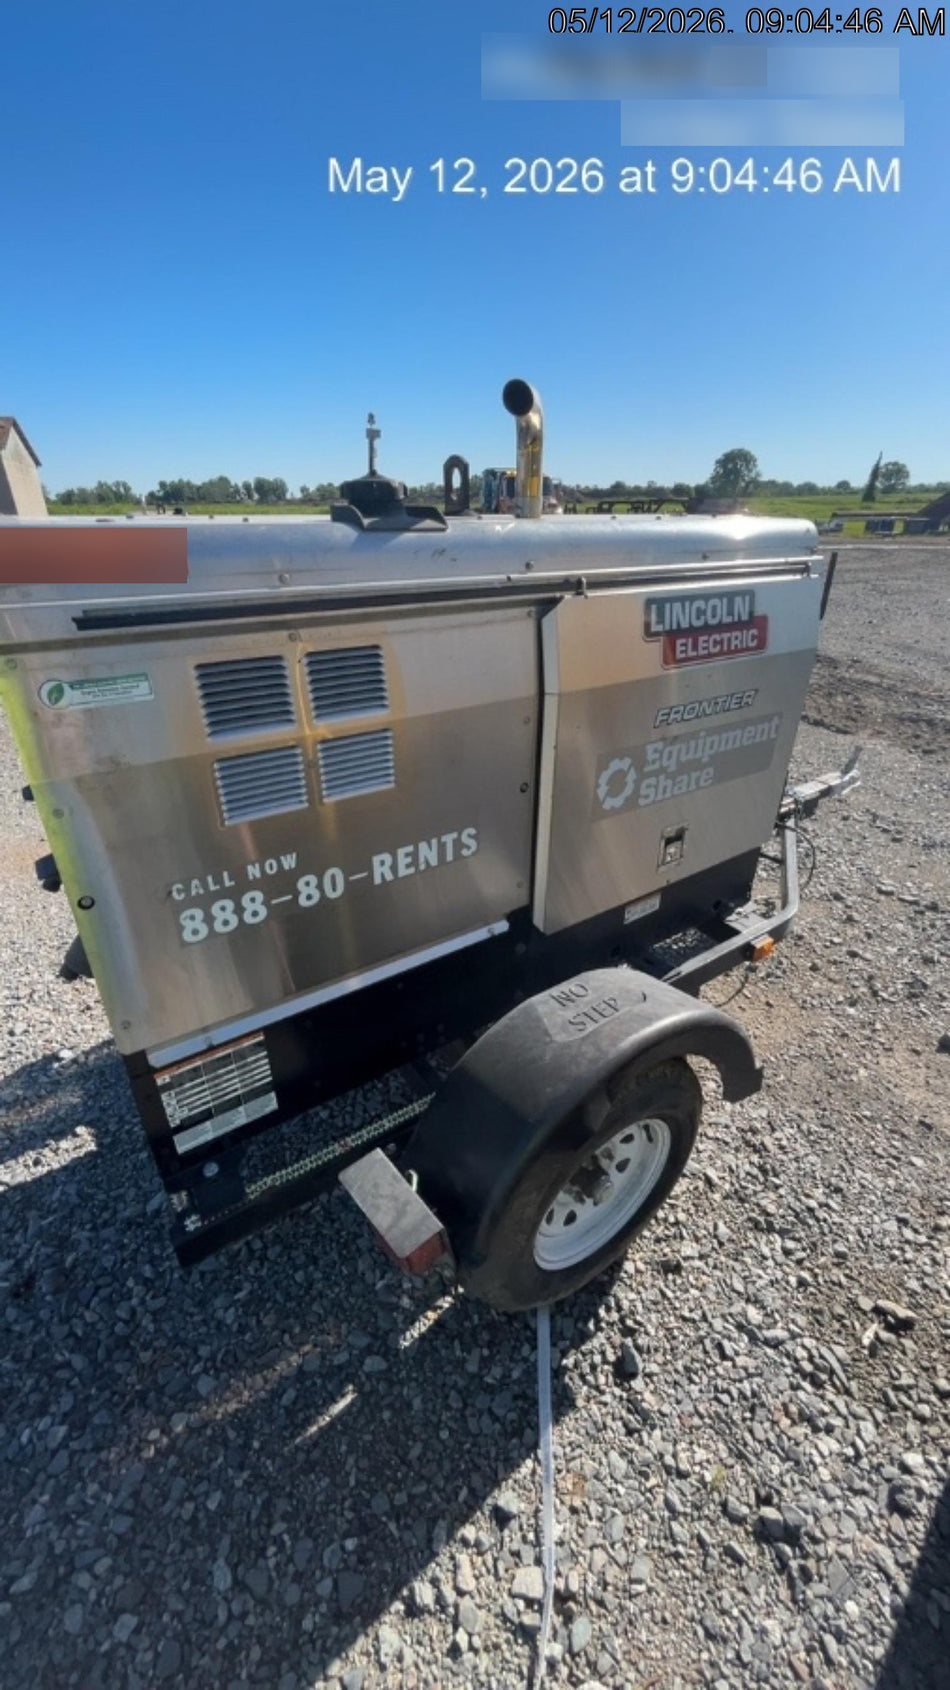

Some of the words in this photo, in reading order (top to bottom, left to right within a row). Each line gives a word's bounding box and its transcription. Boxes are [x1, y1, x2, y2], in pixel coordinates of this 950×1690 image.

[650, 594, 752, 632] LINCOLN
[675, 629, 759, 659] ELECTRIC
[653, 690, 758, 728] FRONTIER
[644, 717, 781, 772] Equipment
[639, 765, 715, 807] Share
[172, 869, 235, 900] CALL
[247, 852, 299, 880] NOW
[179, 827, 479, 944] 888-80-RENTS
[549, 983, 589, 1007] NO
[567, 996, 619, 1032] STEP
